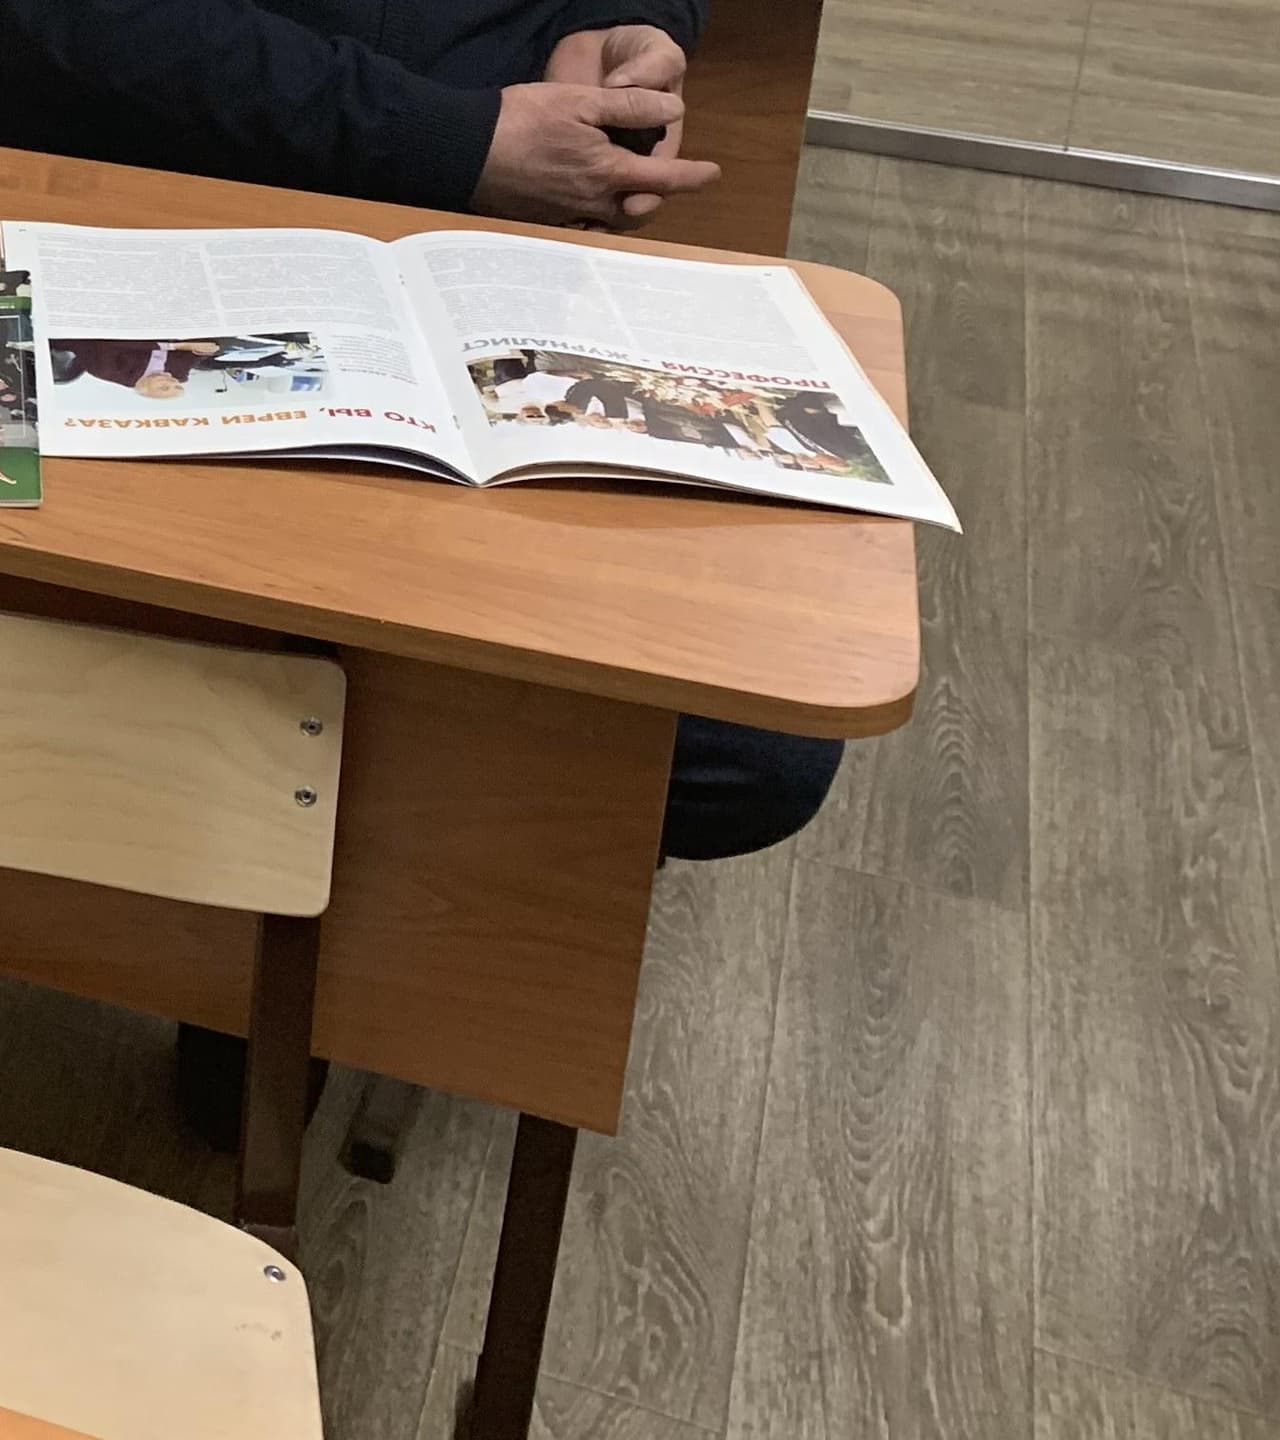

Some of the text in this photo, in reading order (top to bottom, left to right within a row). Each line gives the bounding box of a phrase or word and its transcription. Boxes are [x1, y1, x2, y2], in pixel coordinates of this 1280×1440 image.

[462, 336, 831, 389] ПРОФЕССИЯ ЖУРНАЛИСТ
[64, 406, 438, 434] КТО ВЫ, ЕВРЕИ КАВКАЗА?
